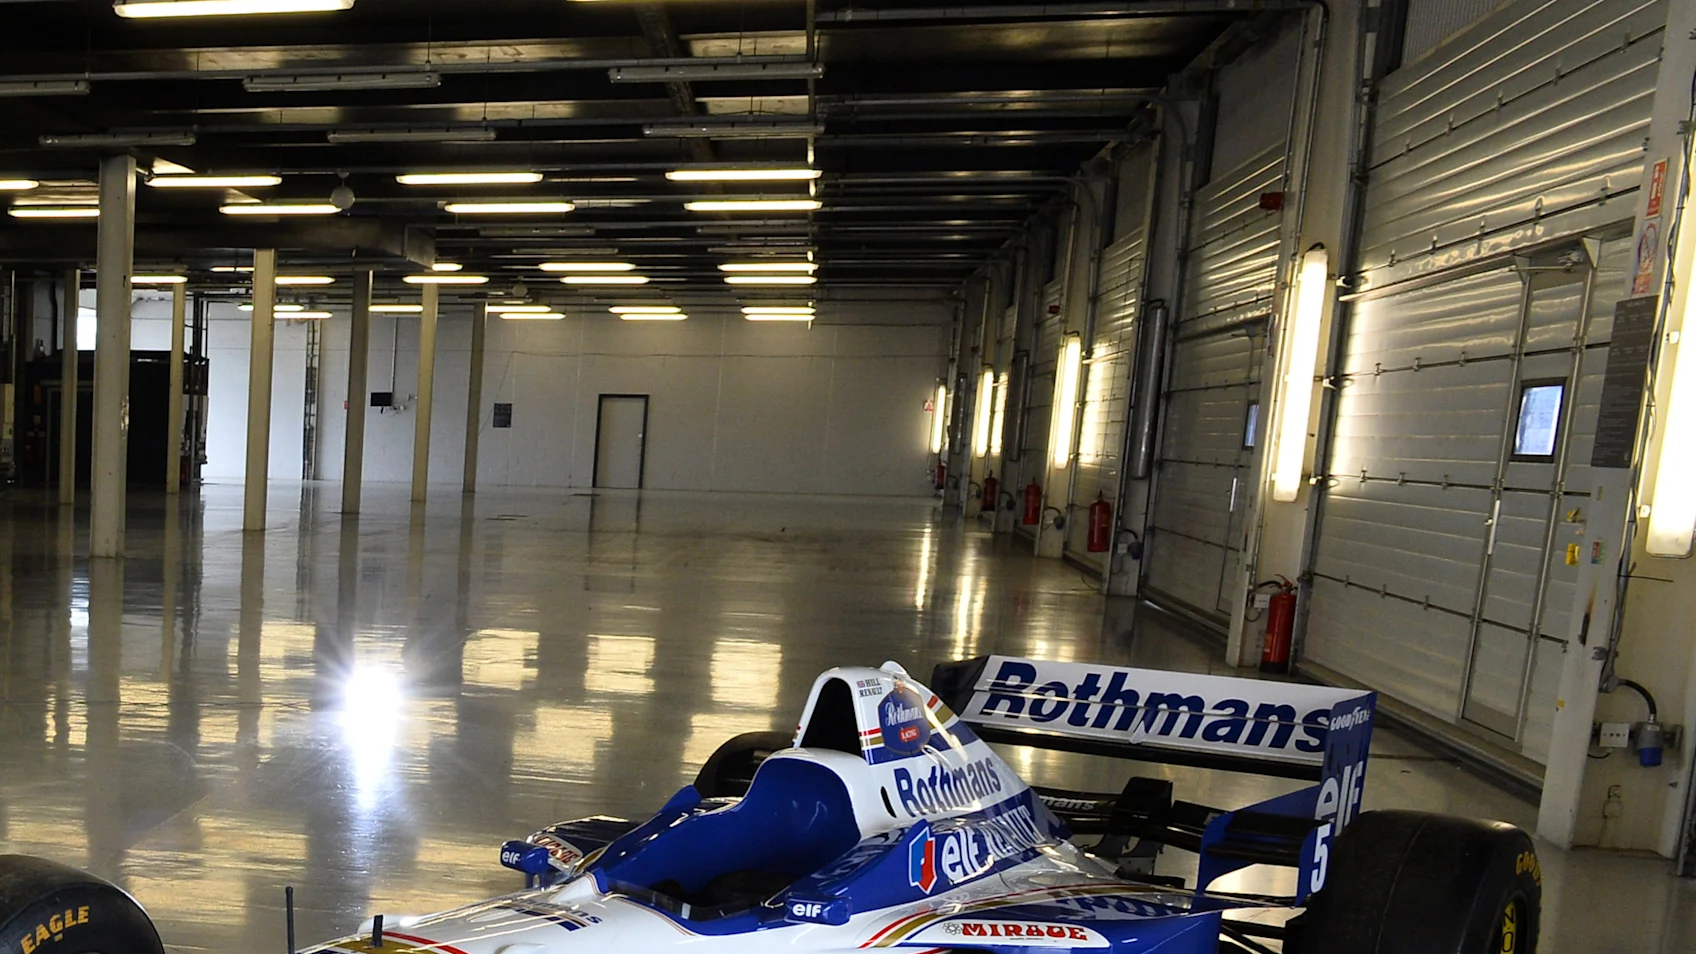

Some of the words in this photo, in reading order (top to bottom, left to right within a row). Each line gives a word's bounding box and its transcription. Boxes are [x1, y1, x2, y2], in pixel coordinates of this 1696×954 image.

[981, 661, 1330, 753] Rothmans
[894, 757, 1002, 818] Rothmans
[1315, 760, 1364, 837] elf
[502, 851, 521, 864] elf
[942, 828, 984, 880] elf
[1311, 823, 1331, 893] 5
[793, 904, 822, 917] elf
[962, 923, 1087, 940] MIRAGE
